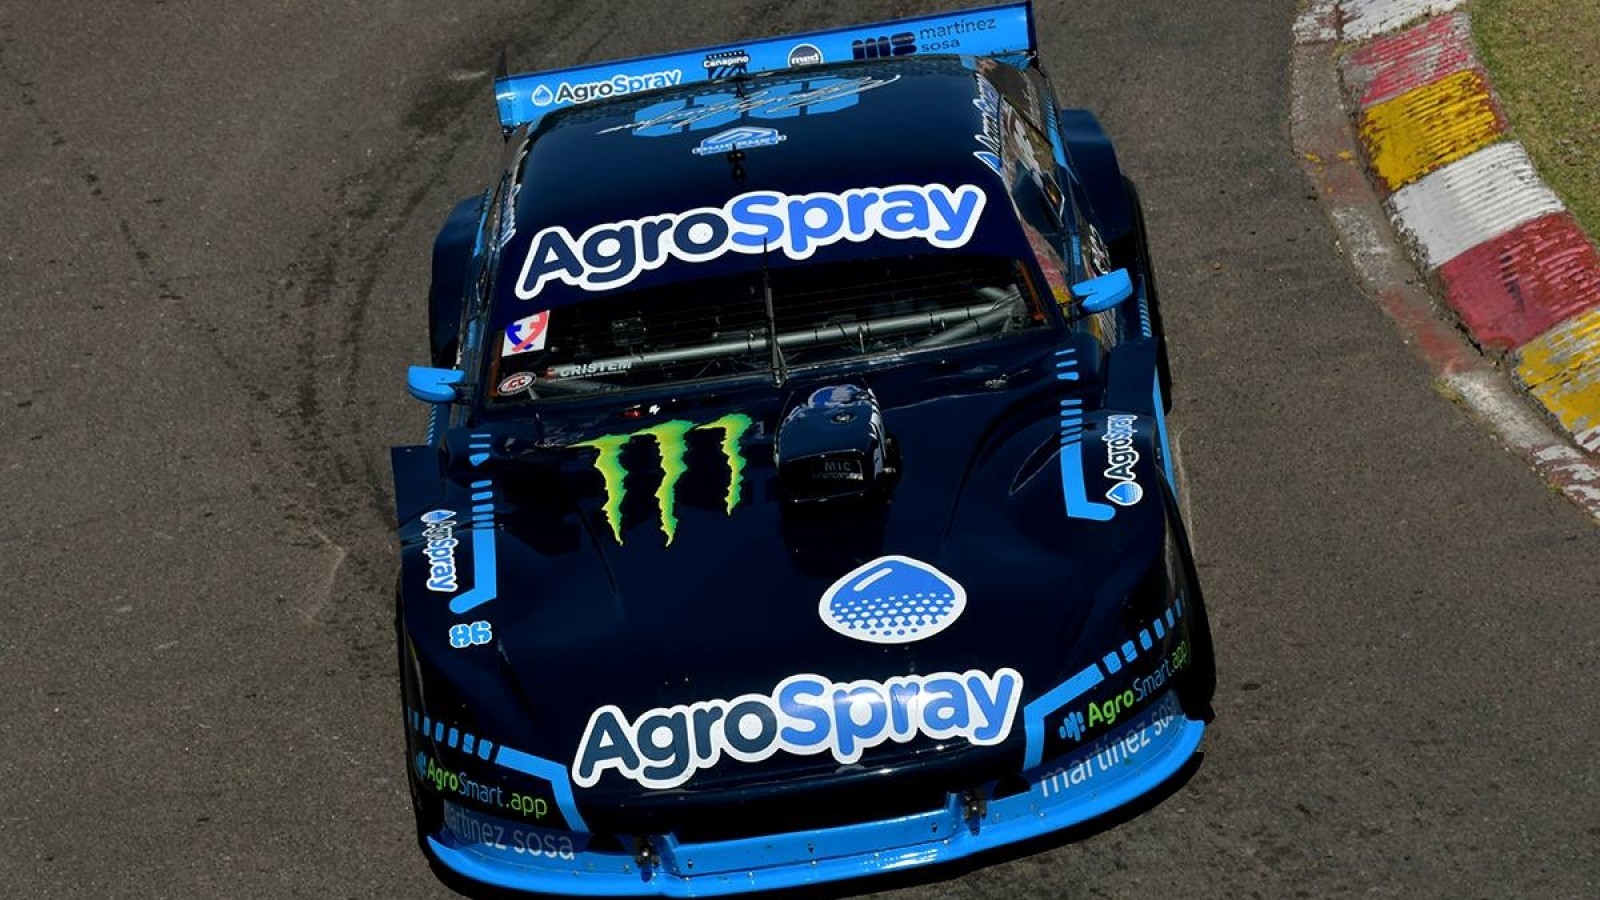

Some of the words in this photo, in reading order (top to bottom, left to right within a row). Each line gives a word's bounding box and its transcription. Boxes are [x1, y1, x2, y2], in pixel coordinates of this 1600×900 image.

[921, 38, 961, 53] sosa
[555, 69, 682, 104] AgroSpray
[514, 183, 987, 300] AgroSpray
[1101, 414, 1140, 481] AgroSpray
[449, 620, 492, 648] 86
[571, 667, 1024, 789] AgroSpray
[427, 757, 548, 820] AgroSmart.app
[512, 829, 576, 861] sosa
